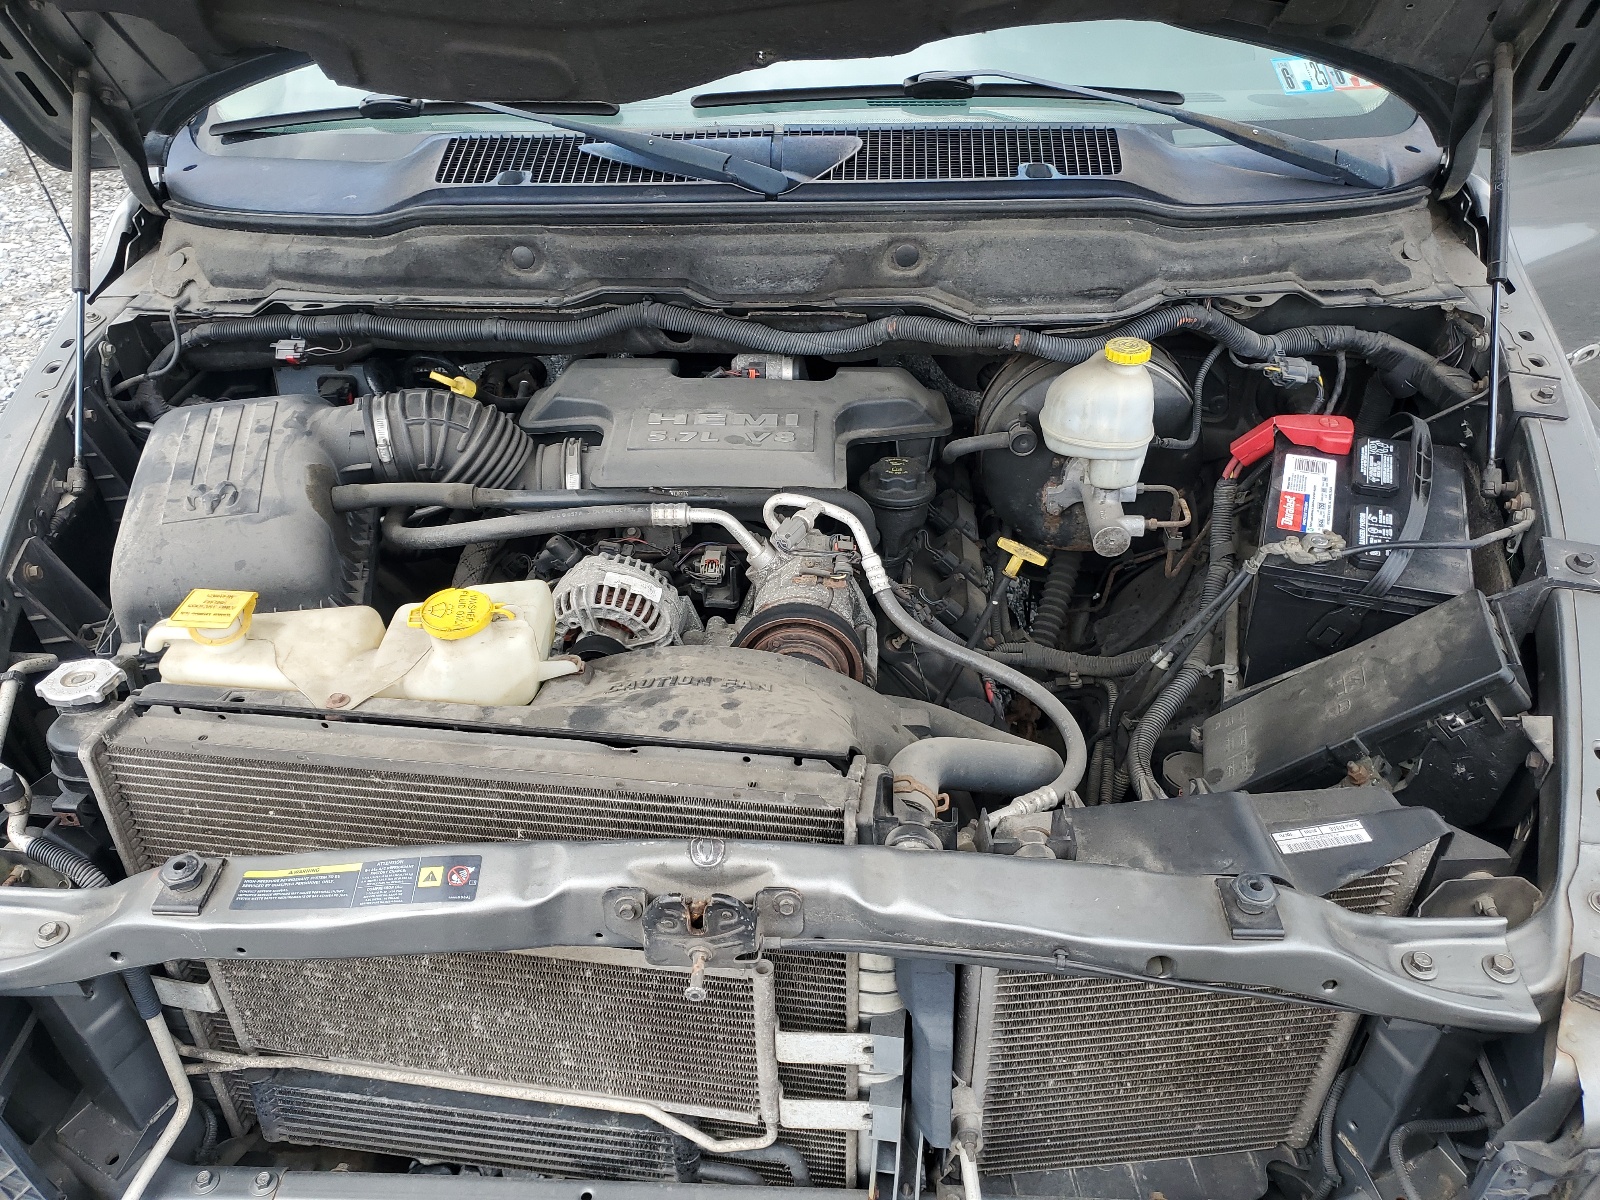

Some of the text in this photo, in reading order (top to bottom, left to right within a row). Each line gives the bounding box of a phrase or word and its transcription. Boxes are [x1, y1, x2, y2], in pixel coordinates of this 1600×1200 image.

[648, 412, 799, 427] HEMI
[648, 430, 796, 444] 5.7L V8
[1280, 495, 1296, 526] Duralast
[457, 590, 469, 610] FLUID
[466, 594, 478, 622] WASHER
[604, 675, 773, 694] CAUTION FAN
